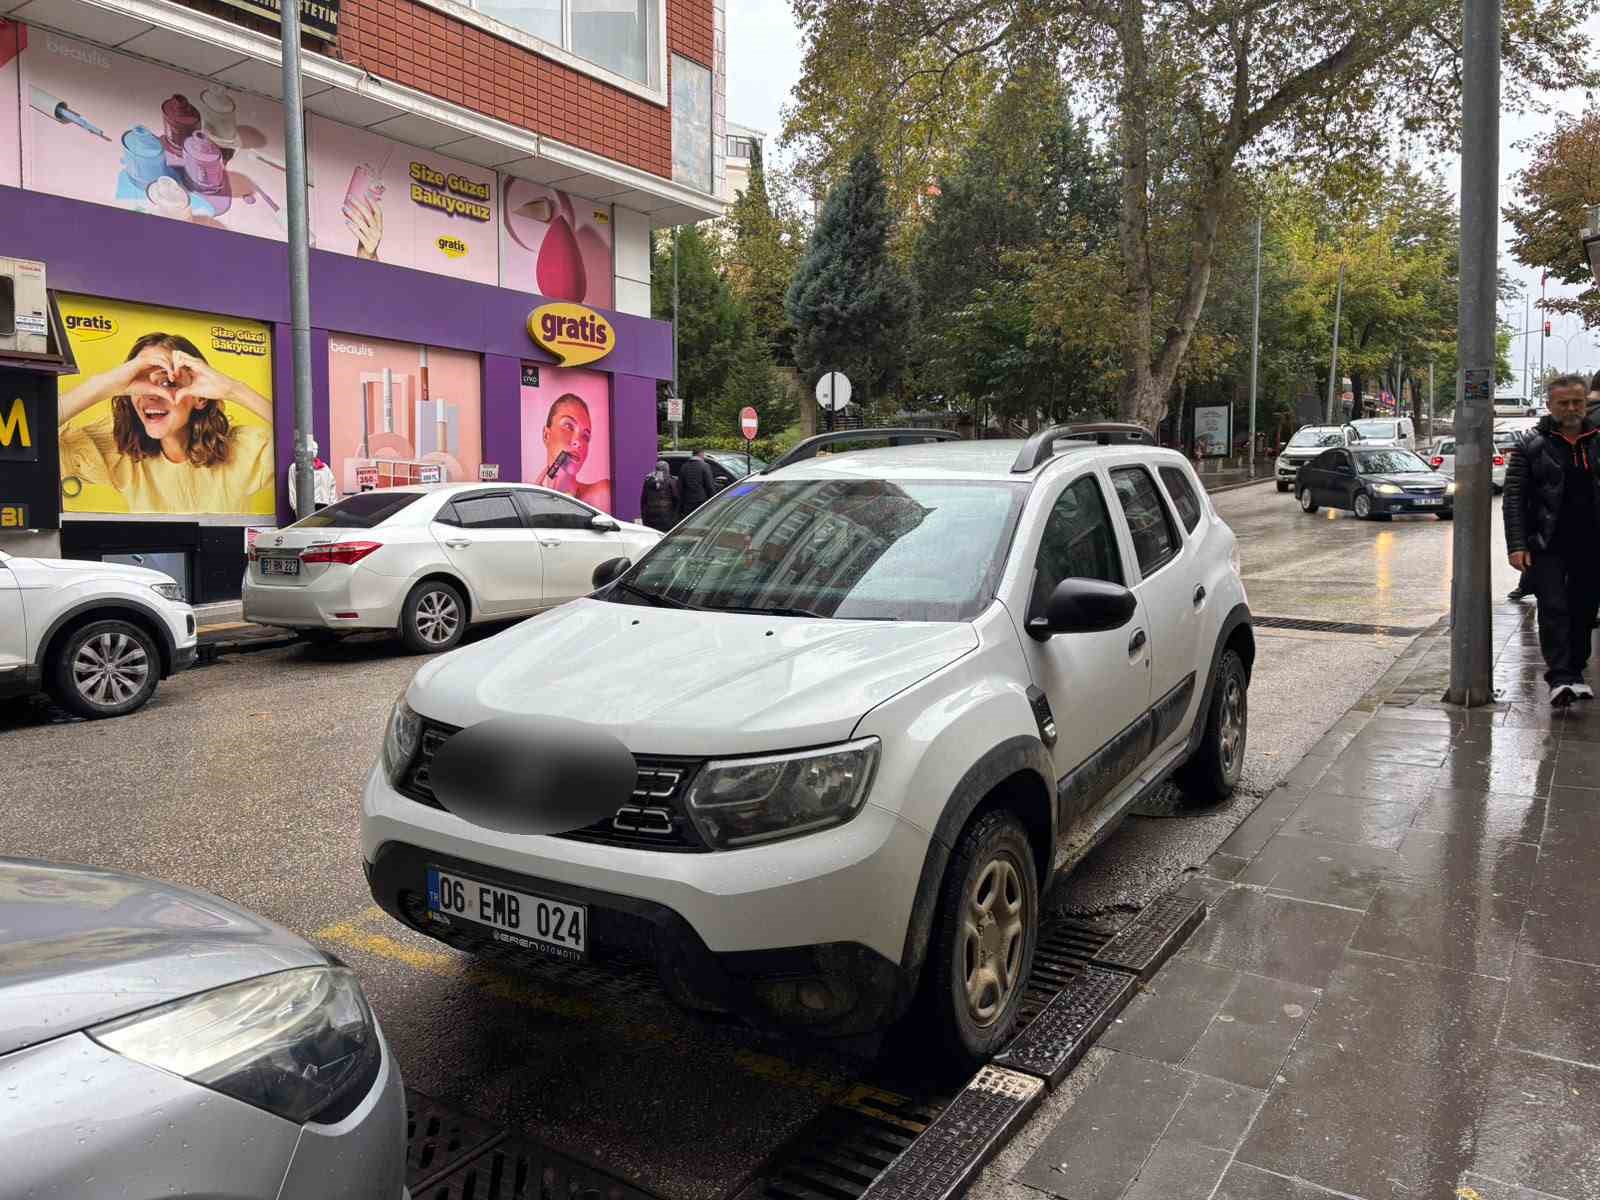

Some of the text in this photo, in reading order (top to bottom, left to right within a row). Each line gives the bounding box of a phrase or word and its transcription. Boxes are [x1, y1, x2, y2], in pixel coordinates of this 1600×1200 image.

[409, 161, 490, 201] Size Güzel
[411, 183, 490, 219] Bakıyoruz
[438, 238, 465, 252] gratis
[66, 315, 113, 330] gratis
[541, 313, 608, 344] gratis
[441, 877, 582, 946] 06 EMB 024
